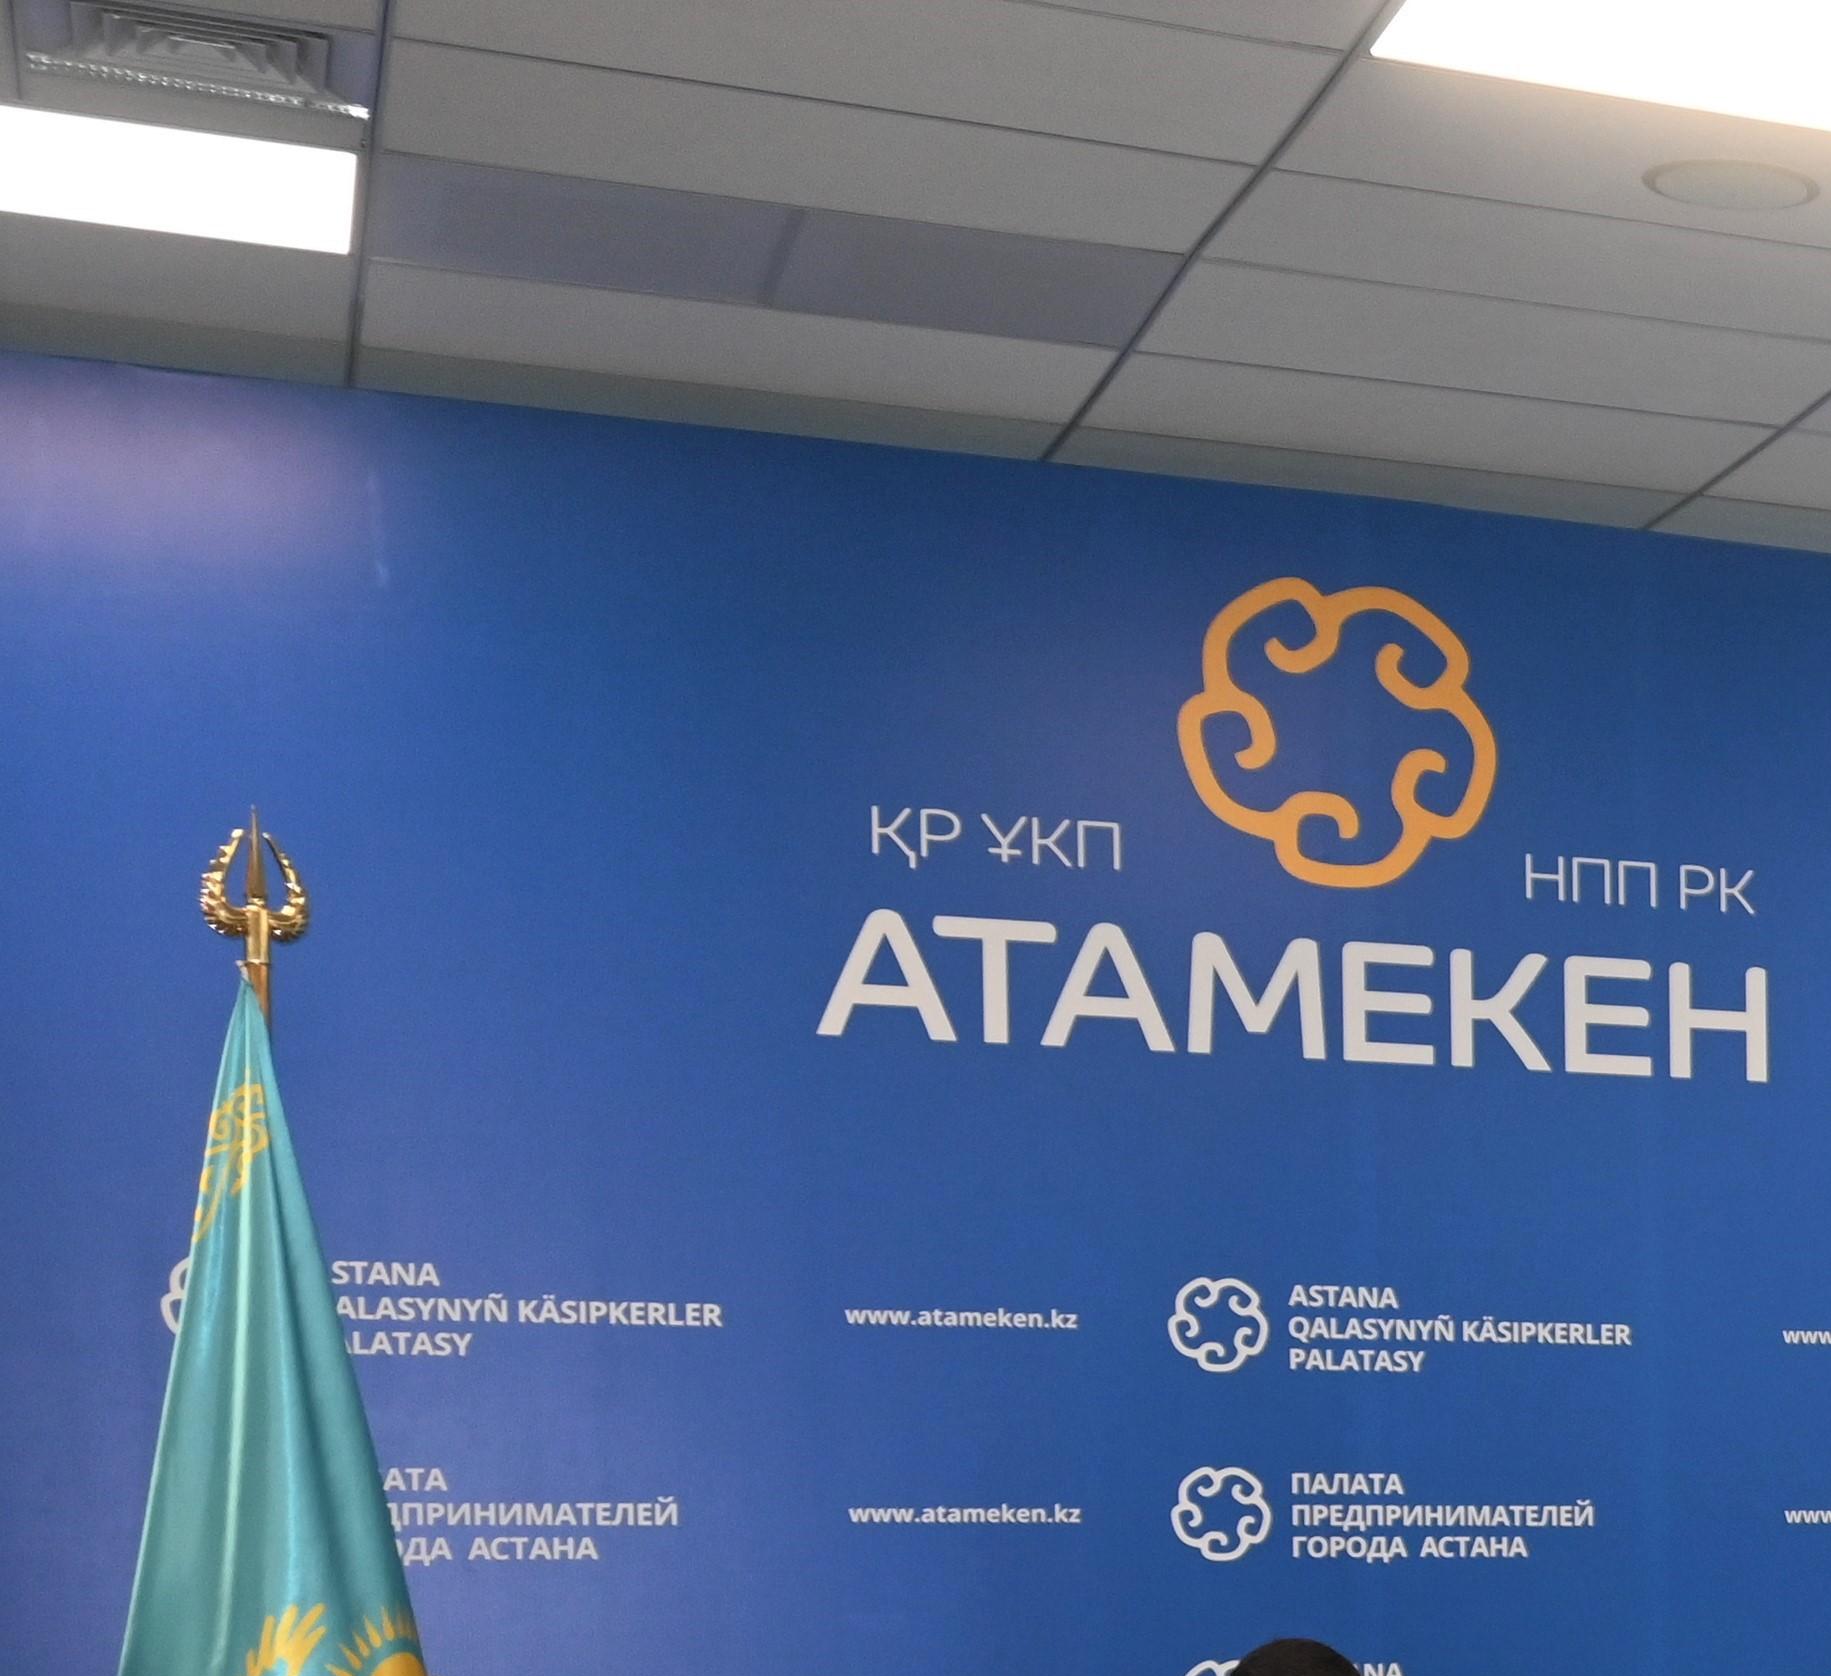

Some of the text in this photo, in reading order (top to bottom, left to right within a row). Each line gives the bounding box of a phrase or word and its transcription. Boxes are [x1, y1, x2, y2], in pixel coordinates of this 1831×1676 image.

[871, 806, 1121, 870] ҚР ҰКП
[1526, 854, 1754, 914] НПП РК
[816, 909, 1768, 1082] АТАМЕКЕН
[332, 1261, 440, 1286] STANA
[1288, 1285, 1399, 1308] ASTANA
[337, 1293, 722, 1326] ALASYNYÑ KÄSIPKERLER
[845, 1308, 1077, 1328] www.atameken.kz
[1289, 1315, 1631, 1345] QALASYNYÑ KÄSIPKERLER
[346, 1331, 472, 1356] LATASY
[1290, 1348, 1424, 1372] PALATASY
[384, 1468, 448, 1491] АТА
[1292, 1473, 1404, 1495] ПАЛАТА
[848, 1504, 1080, 1523] www.atameken.kz
[1292, 1500, 1593, 1531] ПРЕДПРИНИМАТЕЛЕЙ
[468, 1537, 598, 1560] АСТАНА
[1293, 1536, 1528, 1563] ГОРОДА АСТАНА
